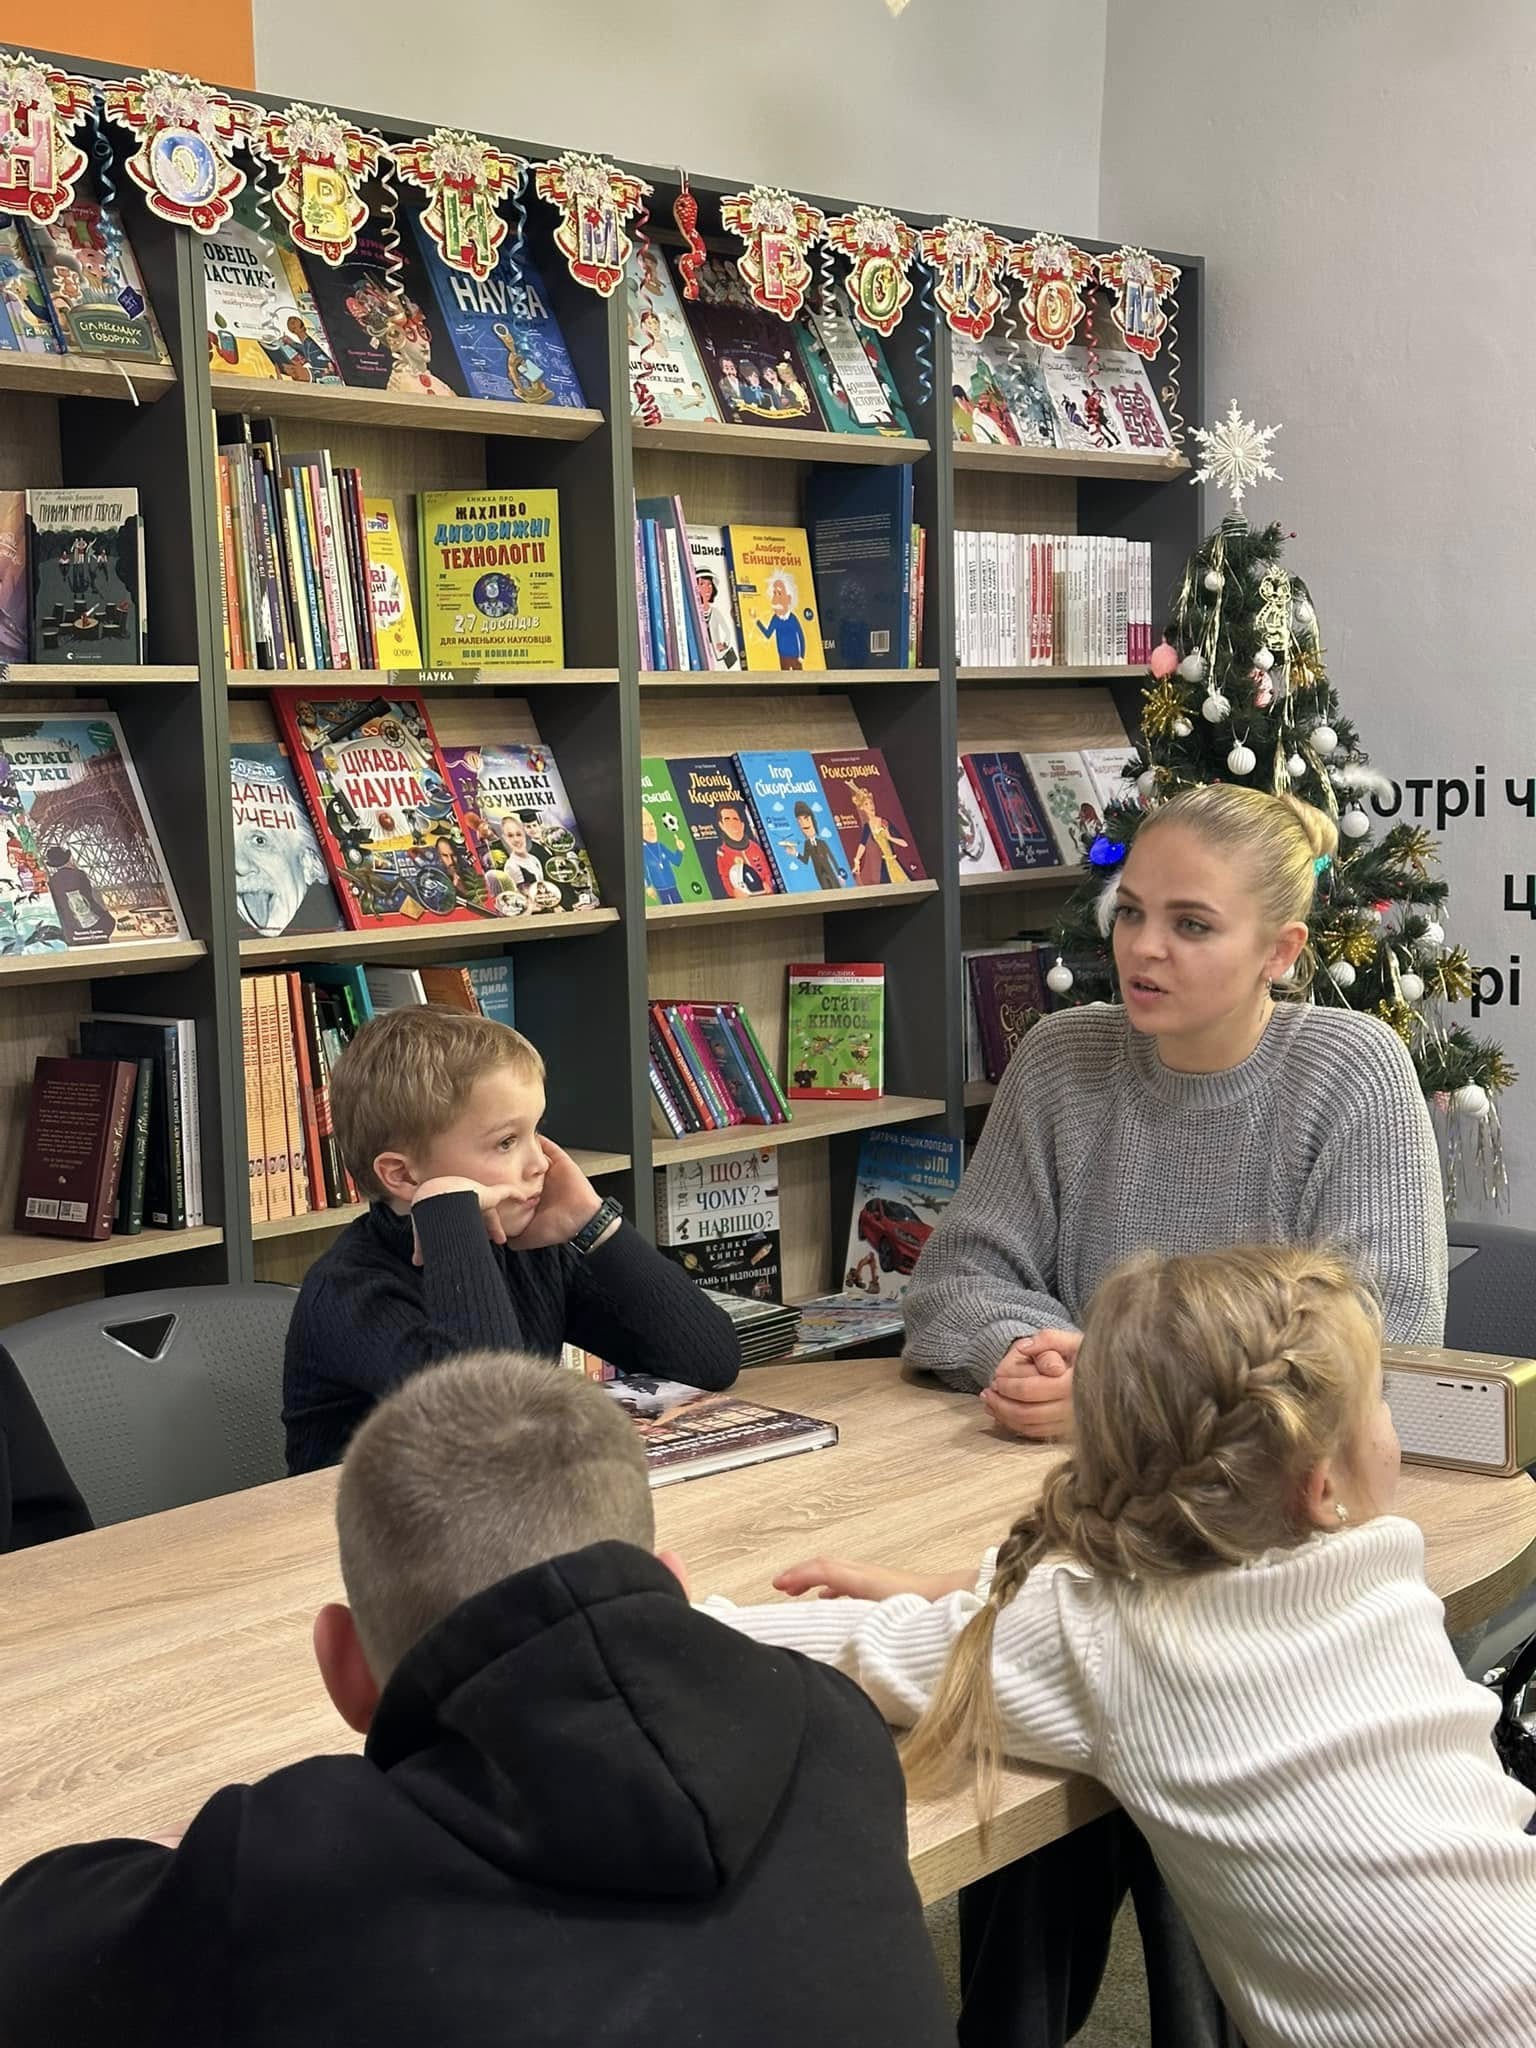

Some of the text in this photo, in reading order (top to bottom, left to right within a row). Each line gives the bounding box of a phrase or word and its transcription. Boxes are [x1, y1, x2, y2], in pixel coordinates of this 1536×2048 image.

[203, 241, 258, 267] ОВЕЦЬ
[456, 502, 527, 521] ЖАХЛИВО
[434, 517, 551, 546] ДИВОВИЖНІ
[441, 541, 546, 570] ТЕХНОЛОГІЇ
[742, 551, 802, 567] Ейнштейн
[755, 543, 786, 554] Альберт
[454, 612, 540, 634] 27 ДОСЛІДІВ
[440, 635, 552, 646] ДЛЯ МАЛЕНЬКИХ НАУКОВЦІВ
[419, 671, 455, 682] НАУКА
[342, 748, 413, 775] ЦІКАВА
[820, 764, 881, 780] Роксолана
[458, 775, 551, 794] МАЛЕНЬКІ
[689, 770, 733, 791] Леонід
[768, 764, 793, 786] Ігор
[345, 776, 430, 809] НАУКА
[688, 789, 745, 808] Каденюк
[755, 779, 818, 799] Сікорський
[1370, 765, 1485, 831] отрі
[463, 791, 557, 810] РОЗУМНИКИ
[232, 806, 297, 830] УЧЕНІ
[798, 981, 824, 995] Як
[1471, 955, 1520, 1018] рі
[710, 1159, 756, 1184] ЩО?
[696, 1184, 760, 1211] ЧОМУ?
[698, 1210, 774, 1238] НАВІЩО?
[705, 1239, 748, 1253] велика
[709, 1249, 745, 1261] книга
[693, 1276, 720, 1287] ИТАНЬ
[729, 1265, 778, 1282] ВІДПОВІДЕЙ
